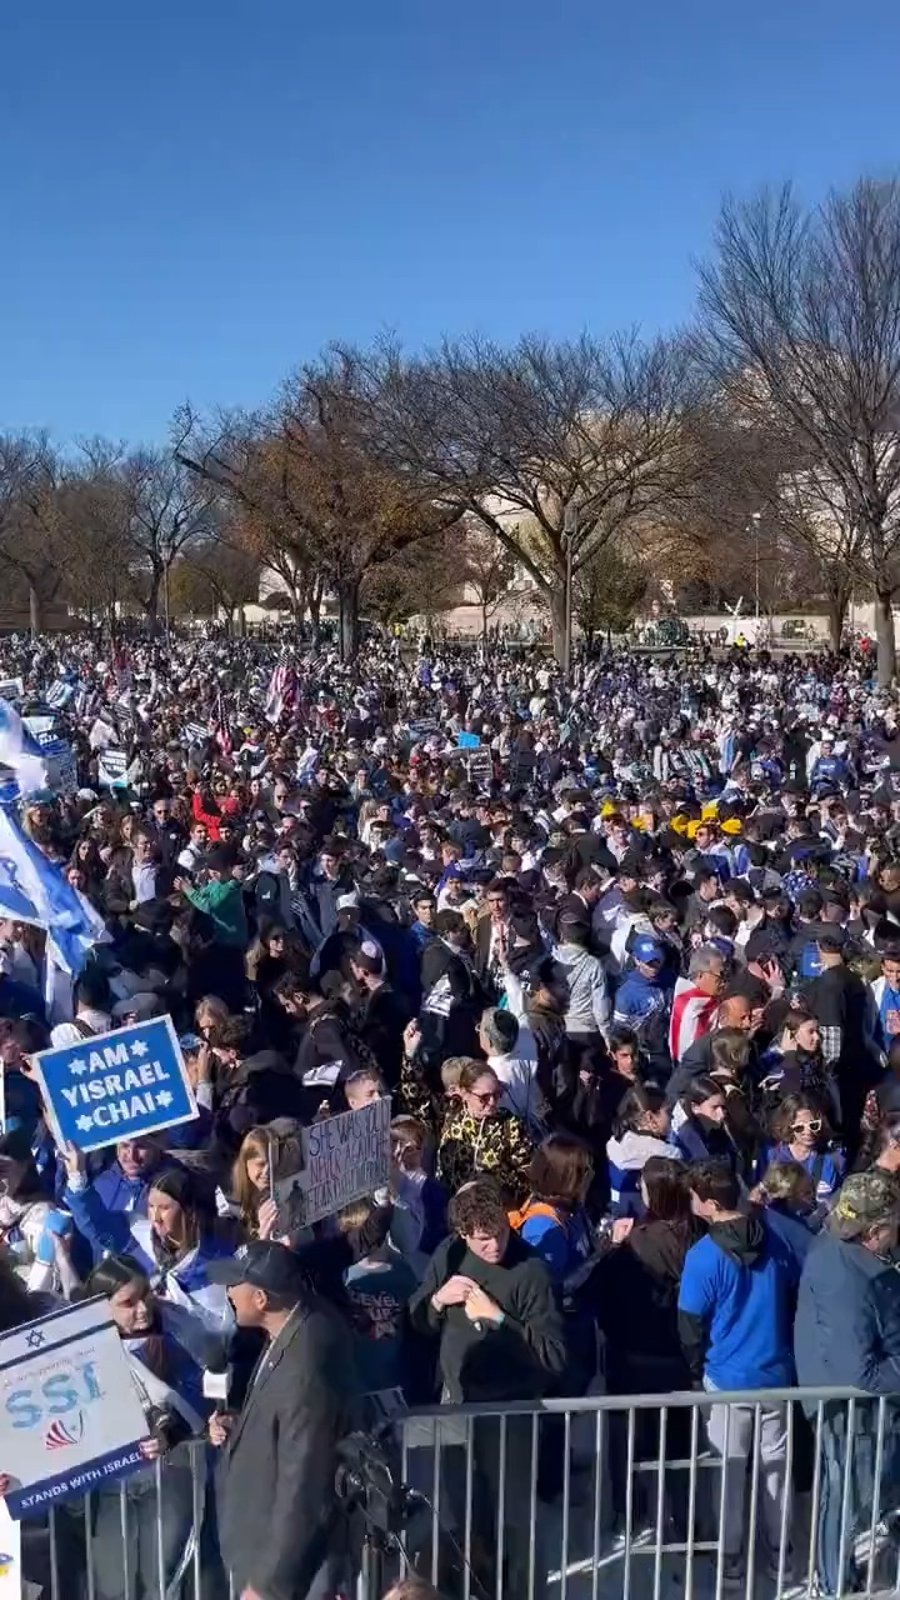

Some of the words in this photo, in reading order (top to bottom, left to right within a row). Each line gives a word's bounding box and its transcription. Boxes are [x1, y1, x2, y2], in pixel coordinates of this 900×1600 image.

[89, 1042, 130, 1074] AM
[61, 1060, 171, 1108] YISRAEL
[92, 1091, 156, 1127] CHAI
[20, 1482, 69, 1509] STANDS
[69, 1469, 101, 1489] WITH
[102, 1451, 142, 1475] ISRAEL
